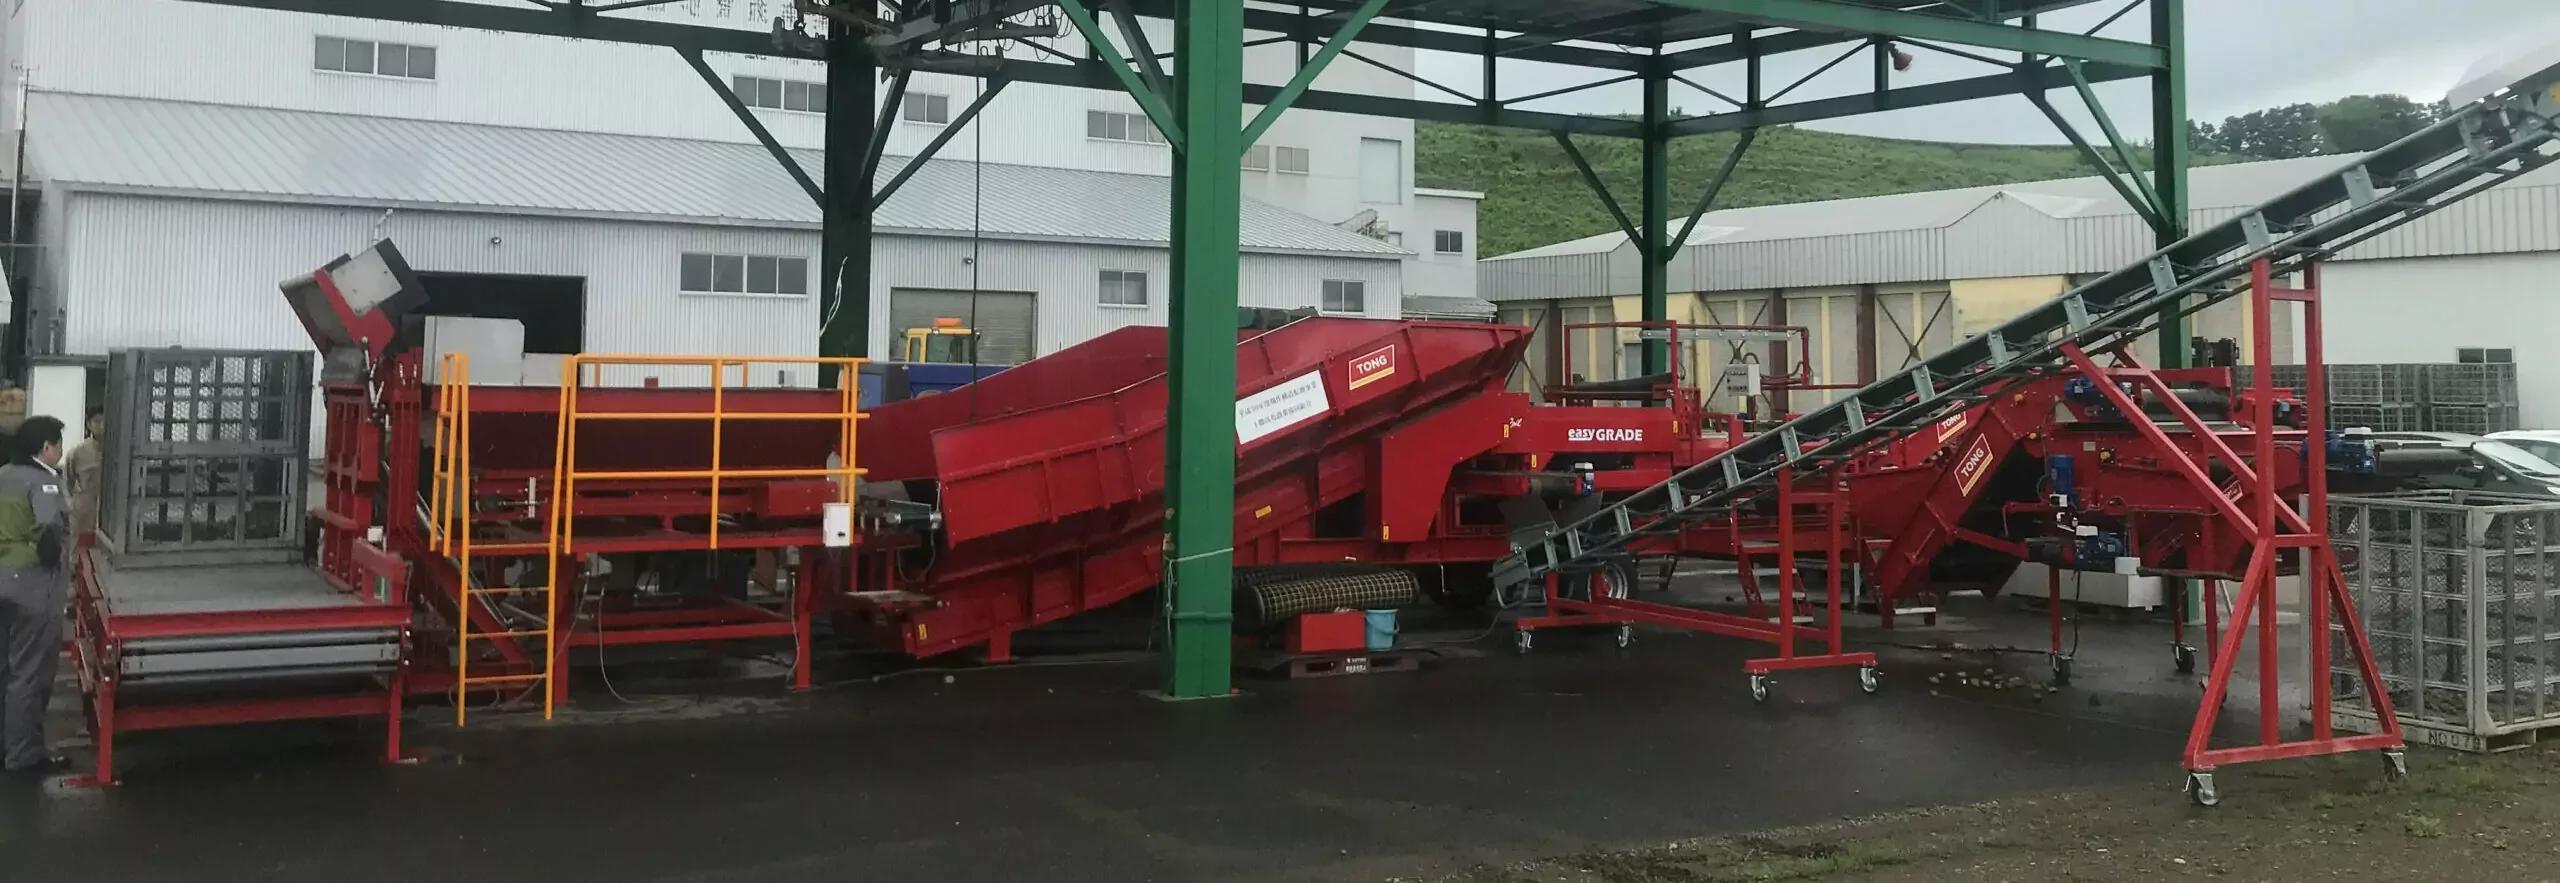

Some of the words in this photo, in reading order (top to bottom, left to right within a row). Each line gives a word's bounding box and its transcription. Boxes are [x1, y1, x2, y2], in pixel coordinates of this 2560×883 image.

[1356, 355, 1387, 374] TONG
[1941, 413, 1961, 429] TONG
[1961, 447, 1984, 476] TONG
